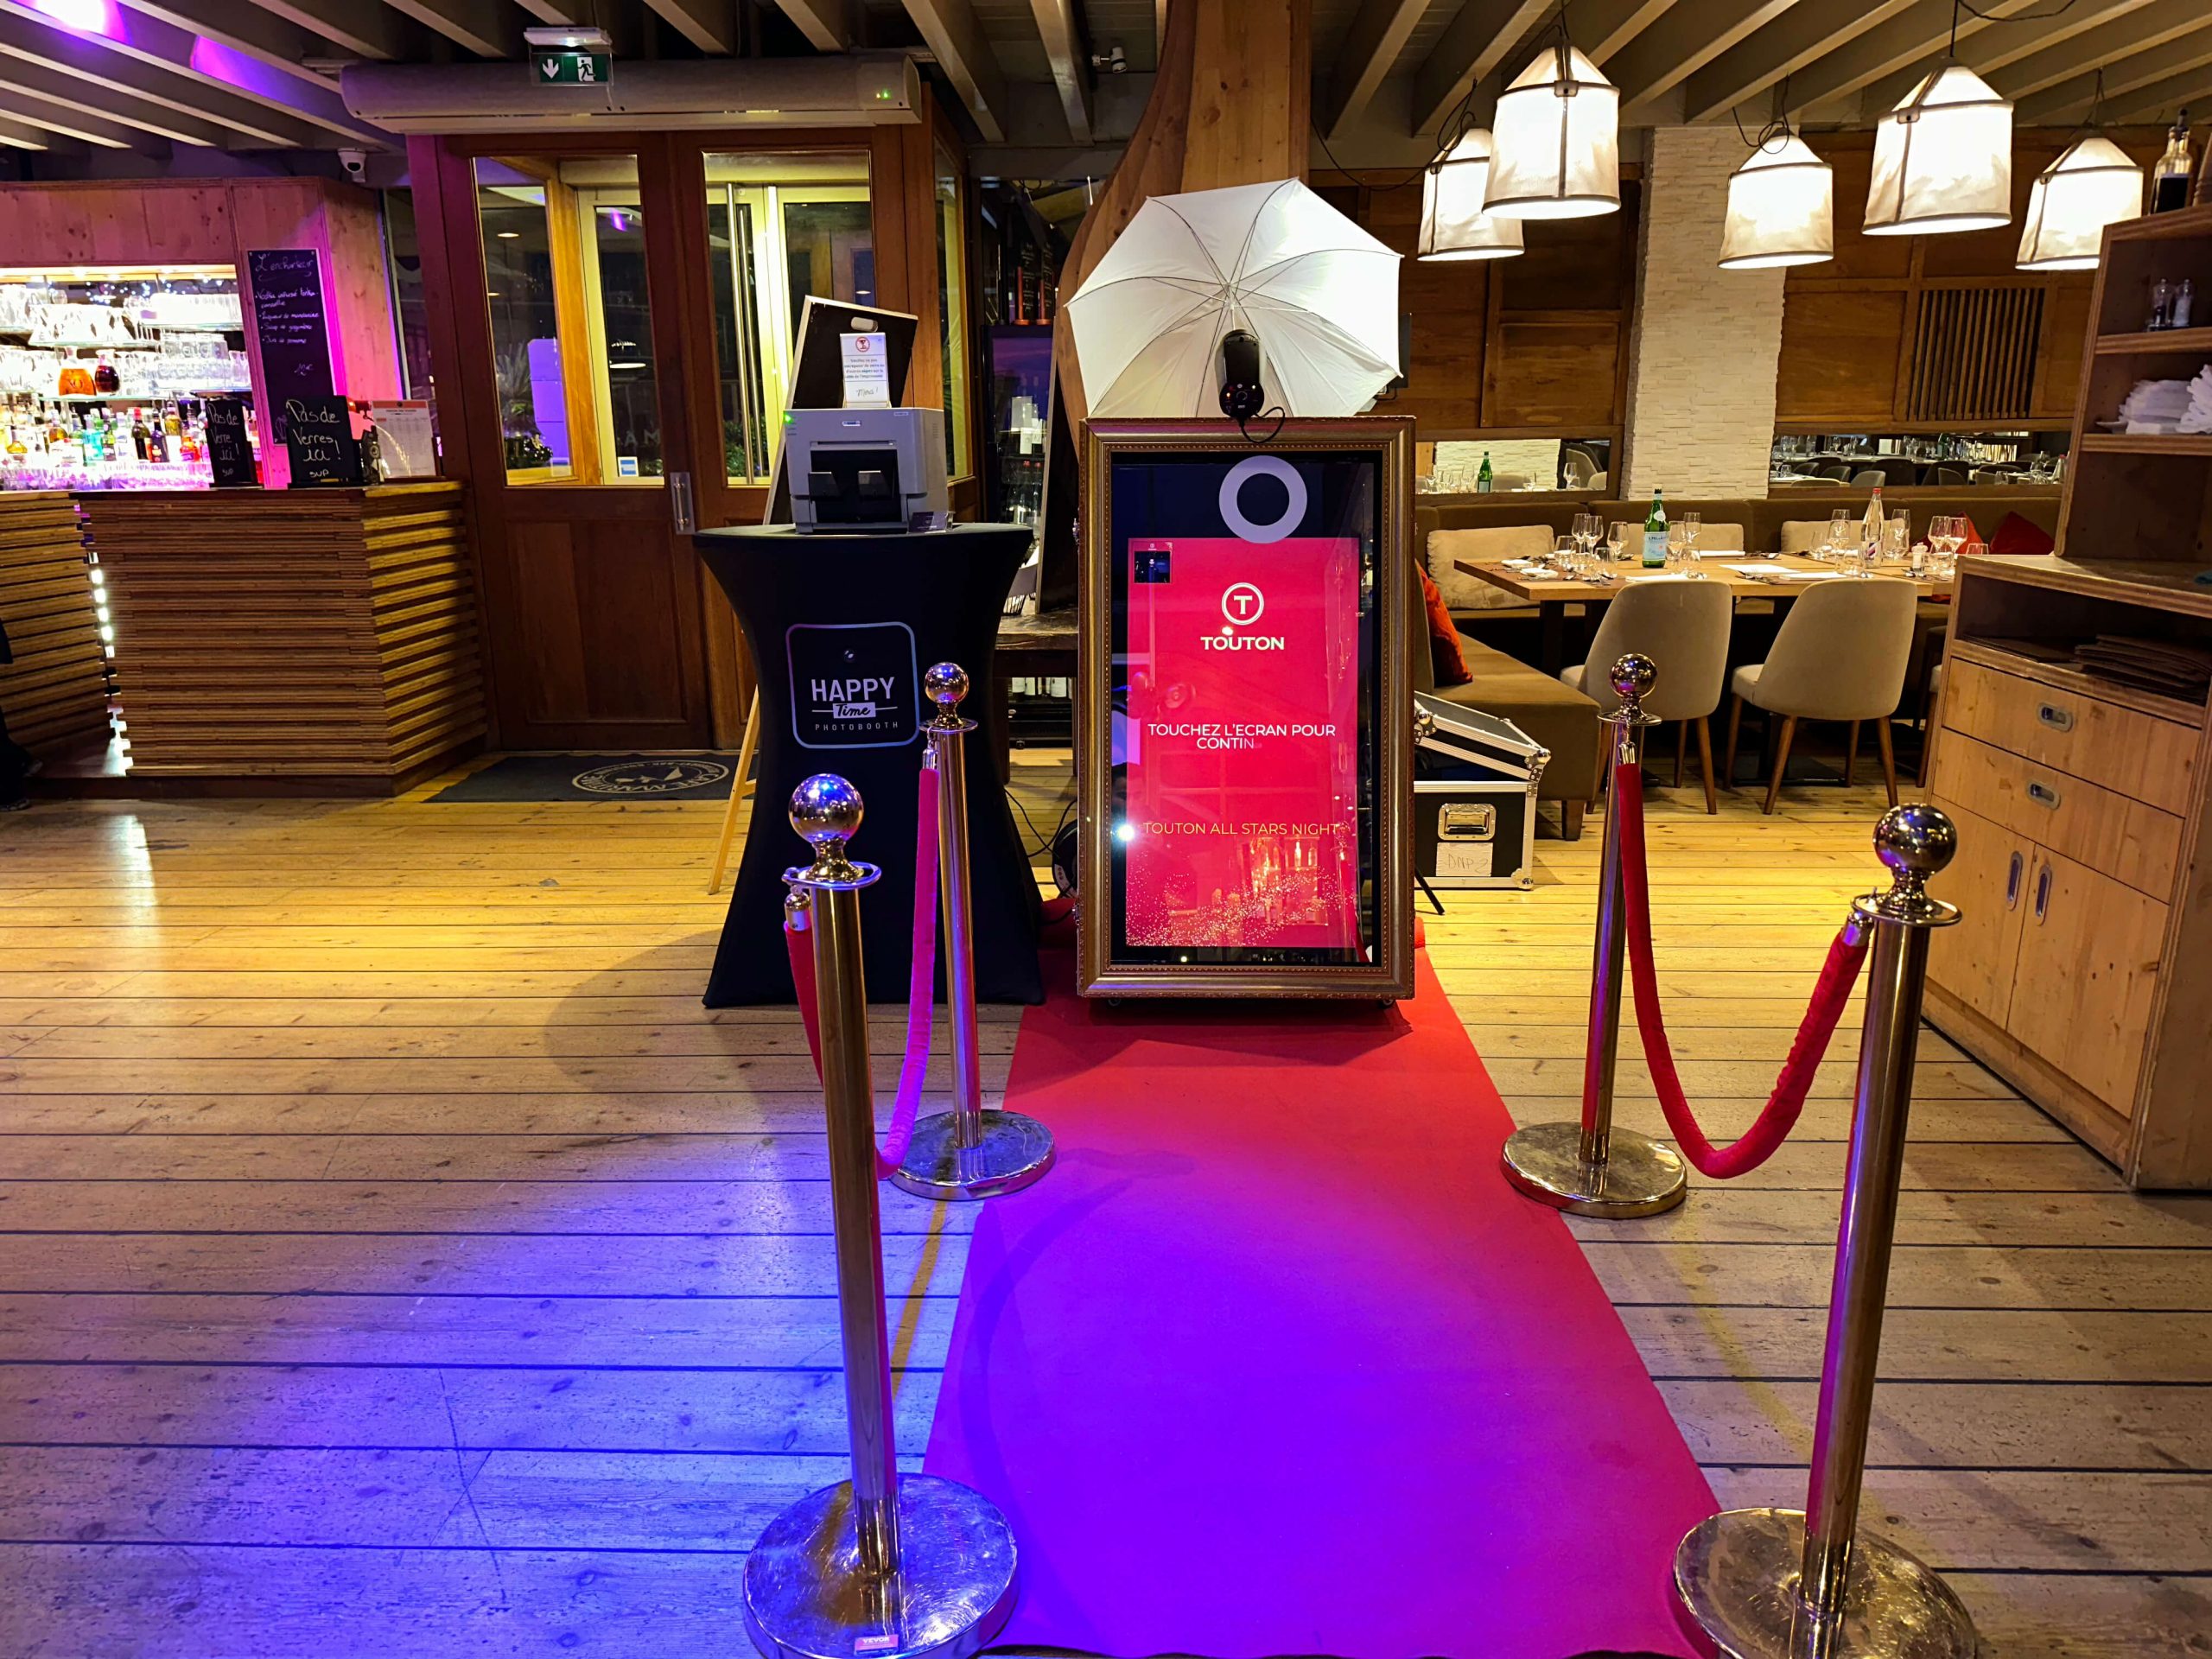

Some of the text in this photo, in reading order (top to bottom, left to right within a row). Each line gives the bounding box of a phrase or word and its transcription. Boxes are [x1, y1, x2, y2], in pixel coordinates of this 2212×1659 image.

[286, 398, 340, 423] Pas de
[1233, 595, 1253, 614] T
[1200, 636, 1285, 651] TOUTON
[811, 677, 894, 702] HAPPY
[835, 703, 871, 717] Time
[815, 721, 899, 731] PHOTOBOOTH
[1147, 723, 1336, 736] TOUCHEZ L'ECRAN POUR
[1142, 823, 1206, 835] TOUTON
[1210, 823, 1237, 835] ALL
[1241, 823, 1287, 835] STARS
